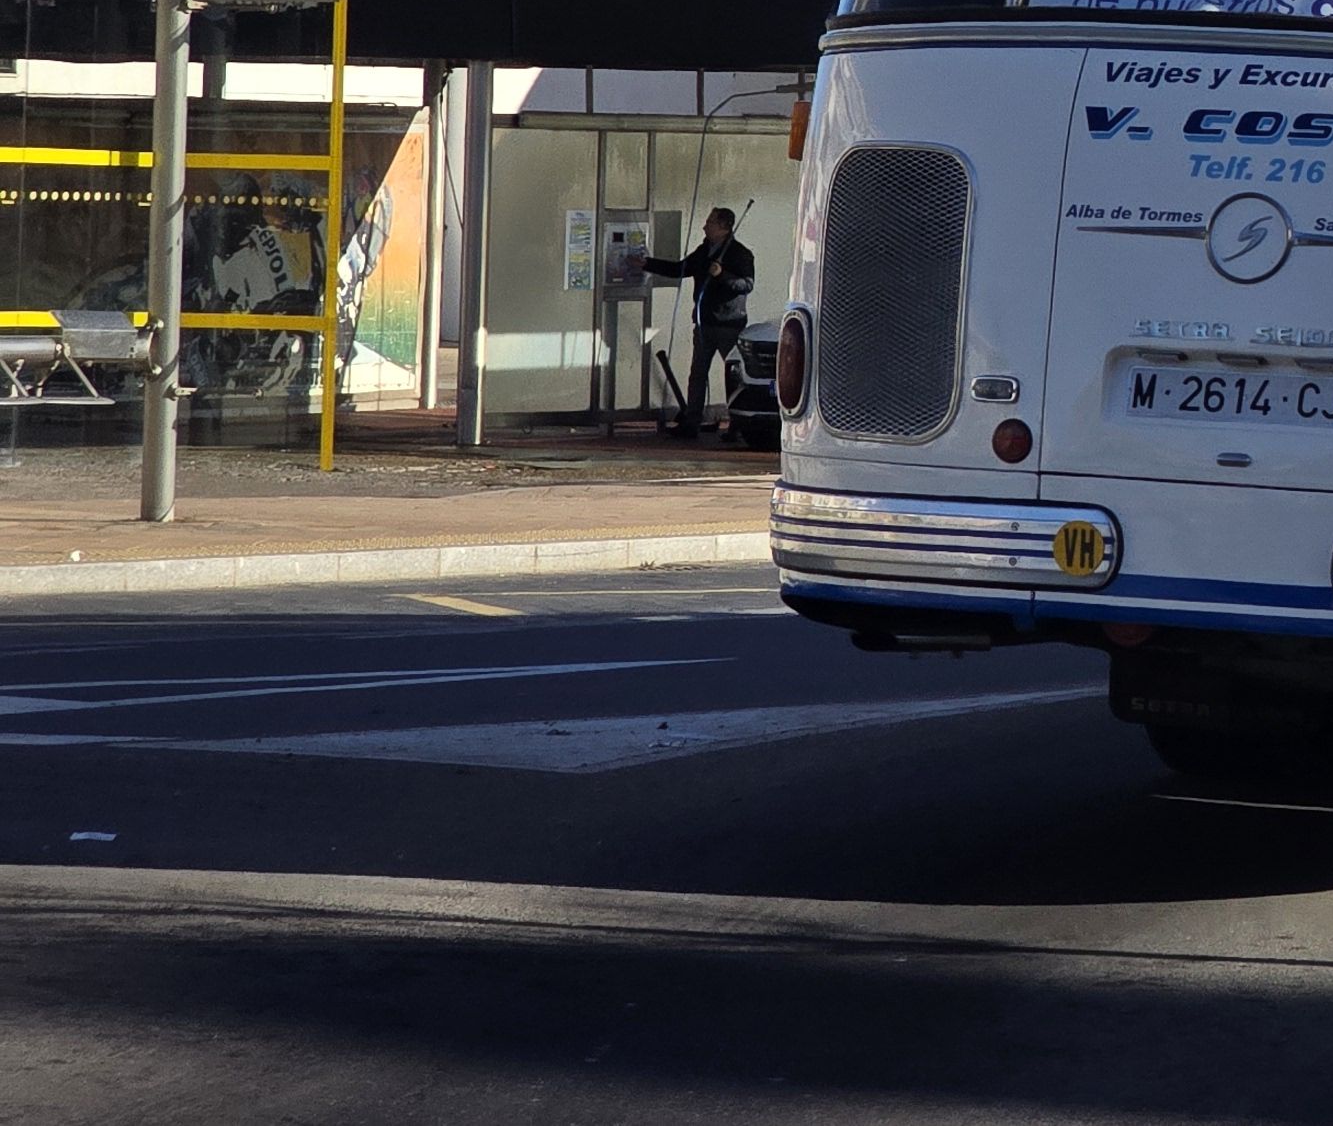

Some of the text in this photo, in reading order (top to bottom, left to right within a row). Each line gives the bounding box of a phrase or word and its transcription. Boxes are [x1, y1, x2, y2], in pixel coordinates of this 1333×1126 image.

[1106, 61, 1201, 89] Viajes
[1209, 68, 1231, 90] y
[1188, 154, 1327, 184] Telf. 216
[1066, 204, 1203, 224] Alba de Tormes
[255, 227, 288, 292] EPSOL
[1064, 527, 1095, 570] VH
